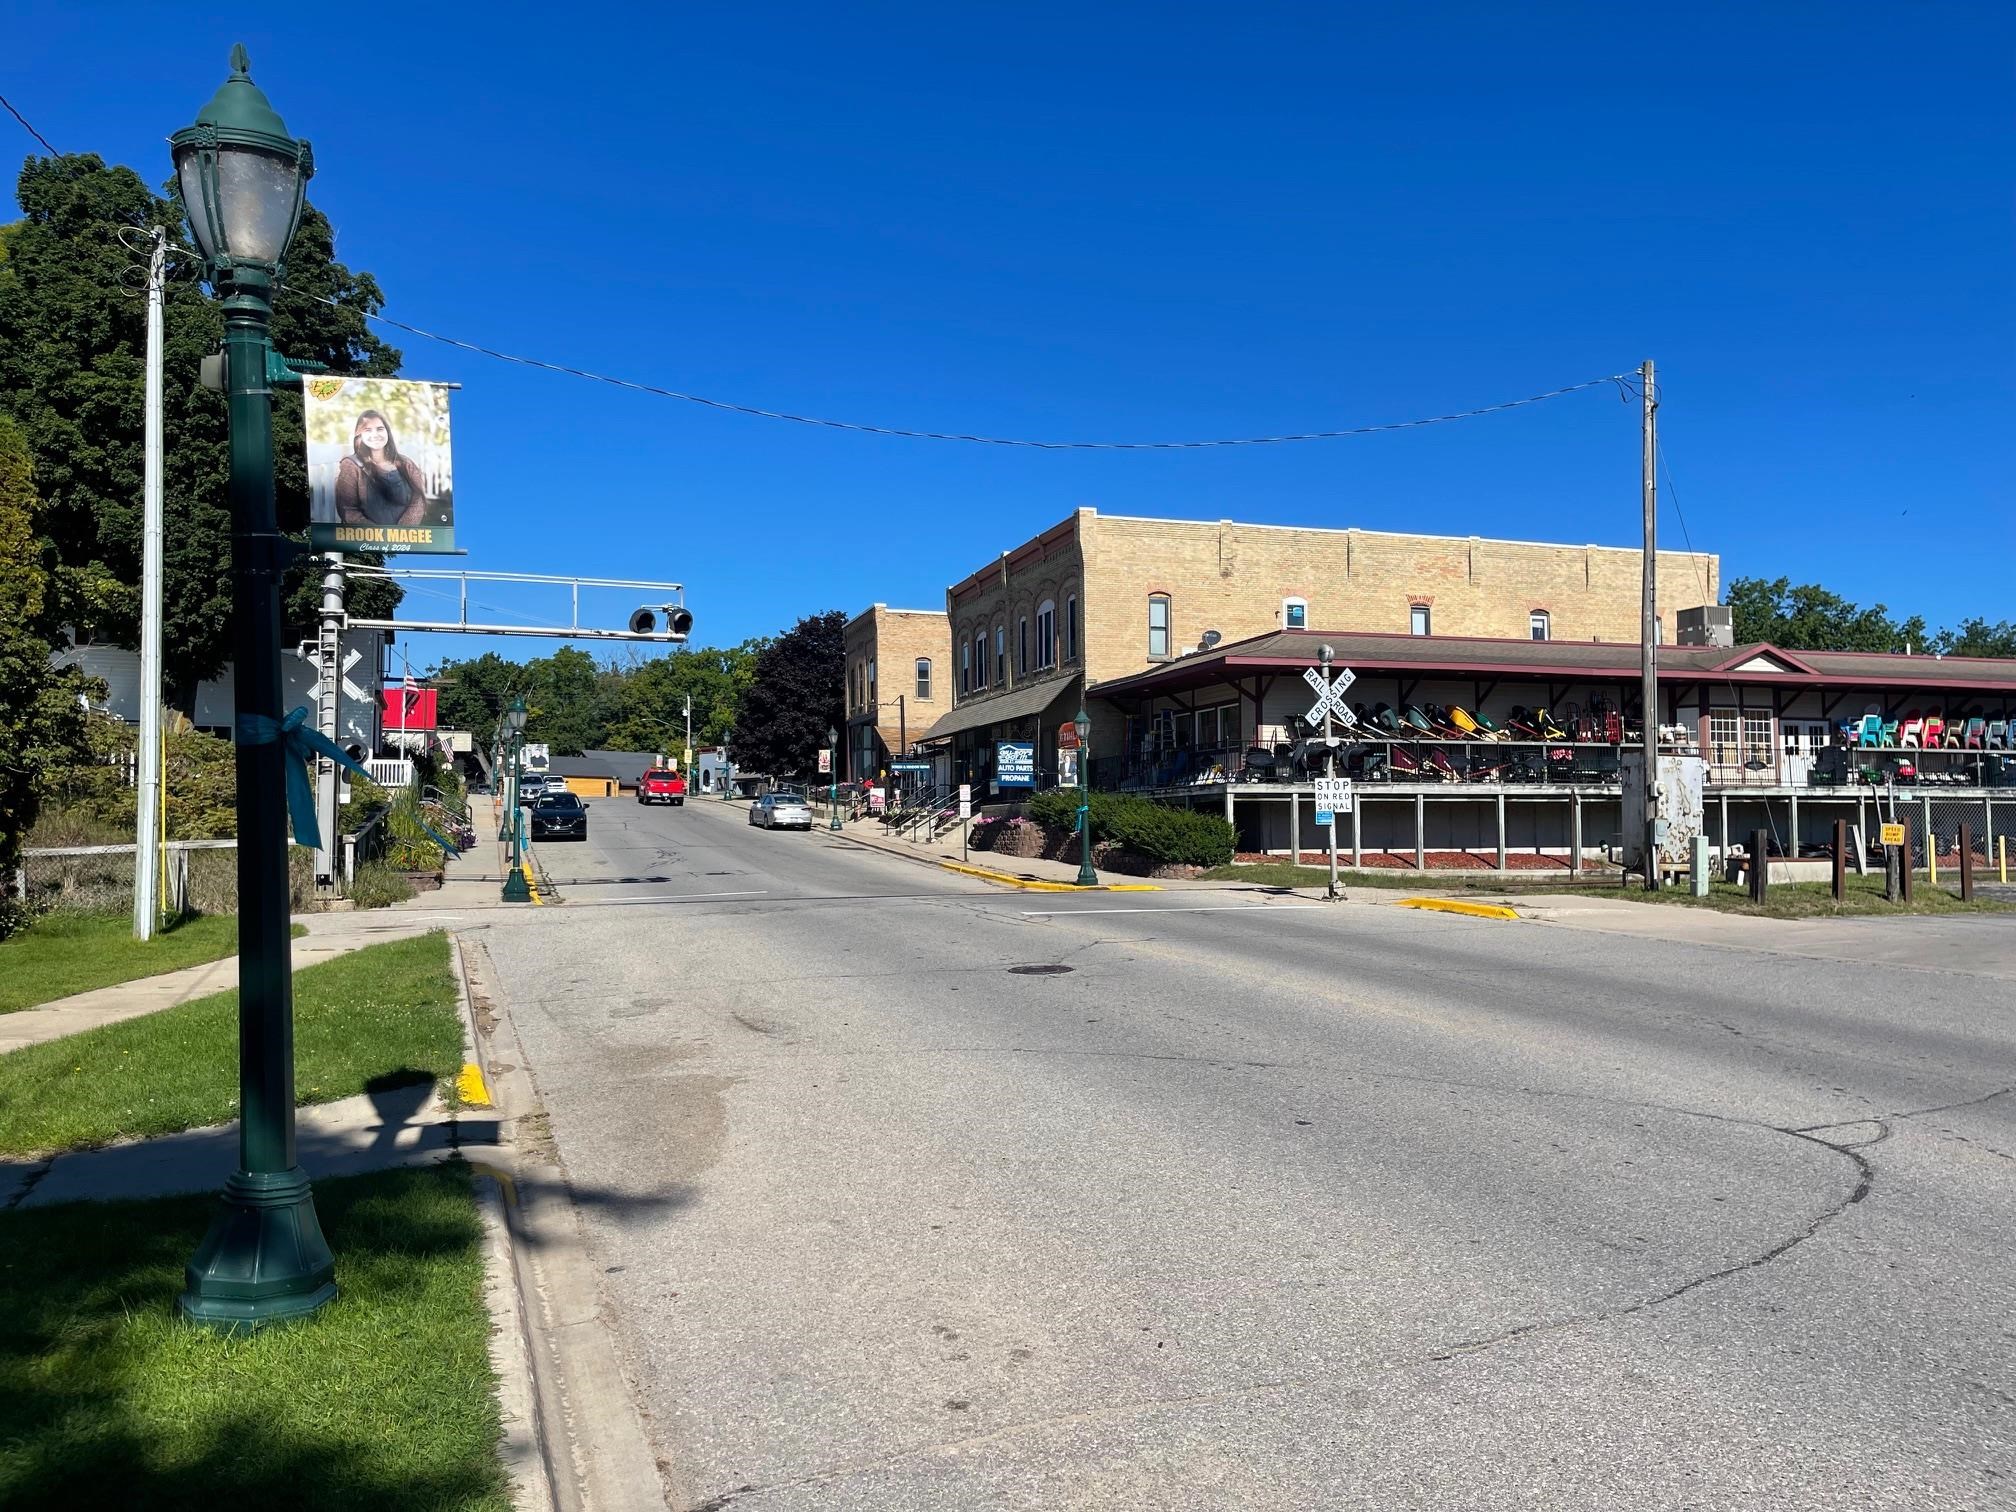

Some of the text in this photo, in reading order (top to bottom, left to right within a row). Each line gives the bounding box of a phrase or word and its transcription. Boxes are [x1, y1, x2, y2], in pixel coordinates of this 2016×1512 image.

[336, 527, 432, 543] BROOK MAGEE
[360, 543, 411, 553] Class of 2024
[1305, 671, 1353, 723] RAIL ROAD
[1310, 674, 1352, 721] CROSSING
[1317, 781, 1349, 790] STOP
